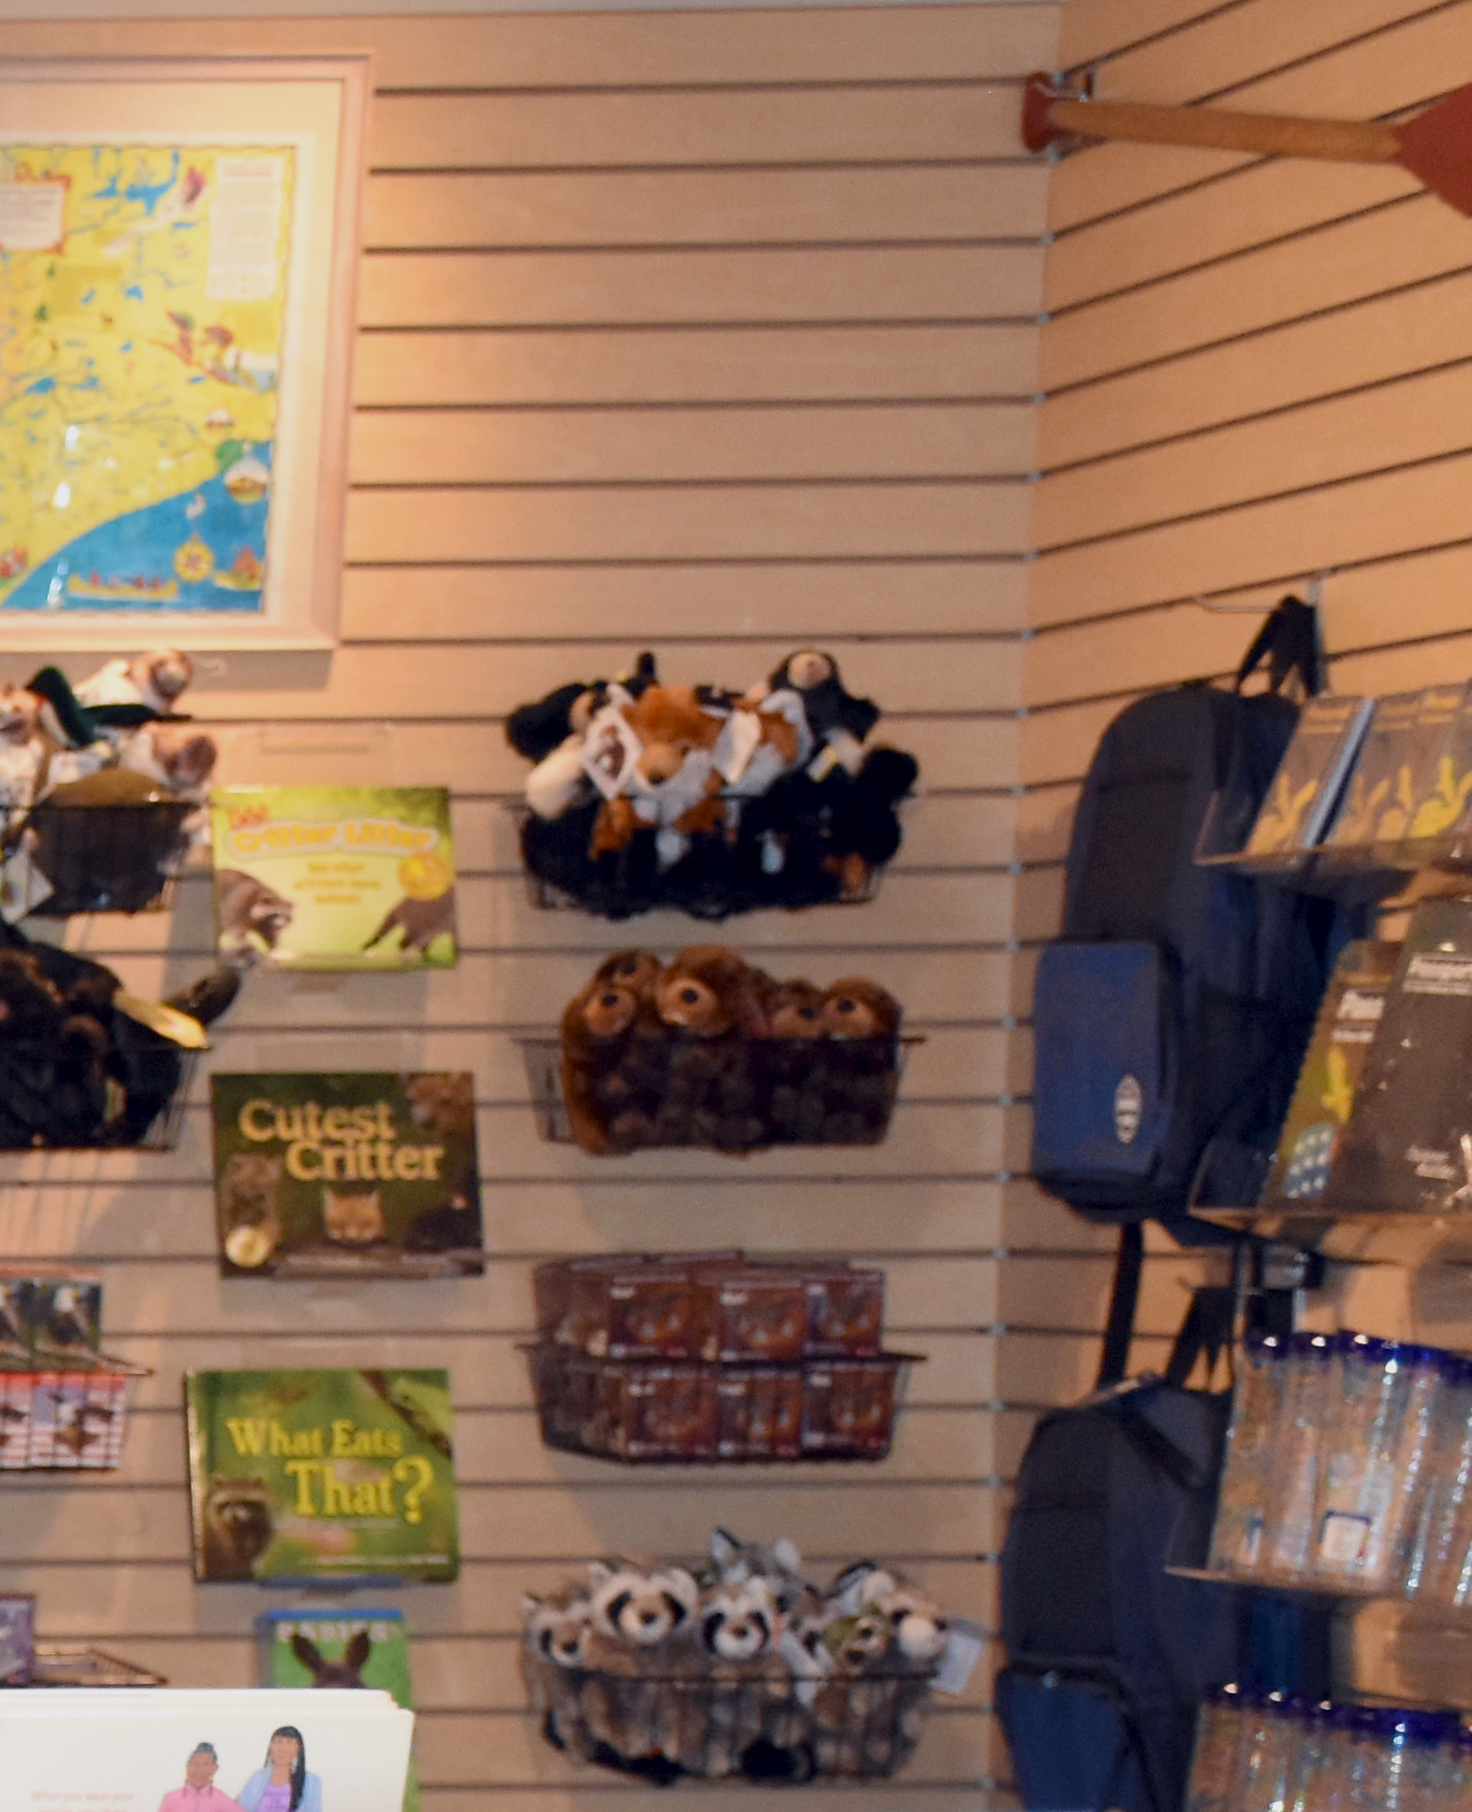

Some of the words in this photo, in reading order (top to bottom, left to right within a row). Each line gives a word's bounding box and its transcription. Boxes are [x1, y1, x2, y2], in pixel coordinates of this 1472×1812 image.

[238, 1098, 396, 1142] Cutest
[285, 1139, 445, 1182] Critter
[225, 1416, 324, 1458] What
[331, 1417, 403, 1457] Eats
[285, 1454, 435, 1525] That?
